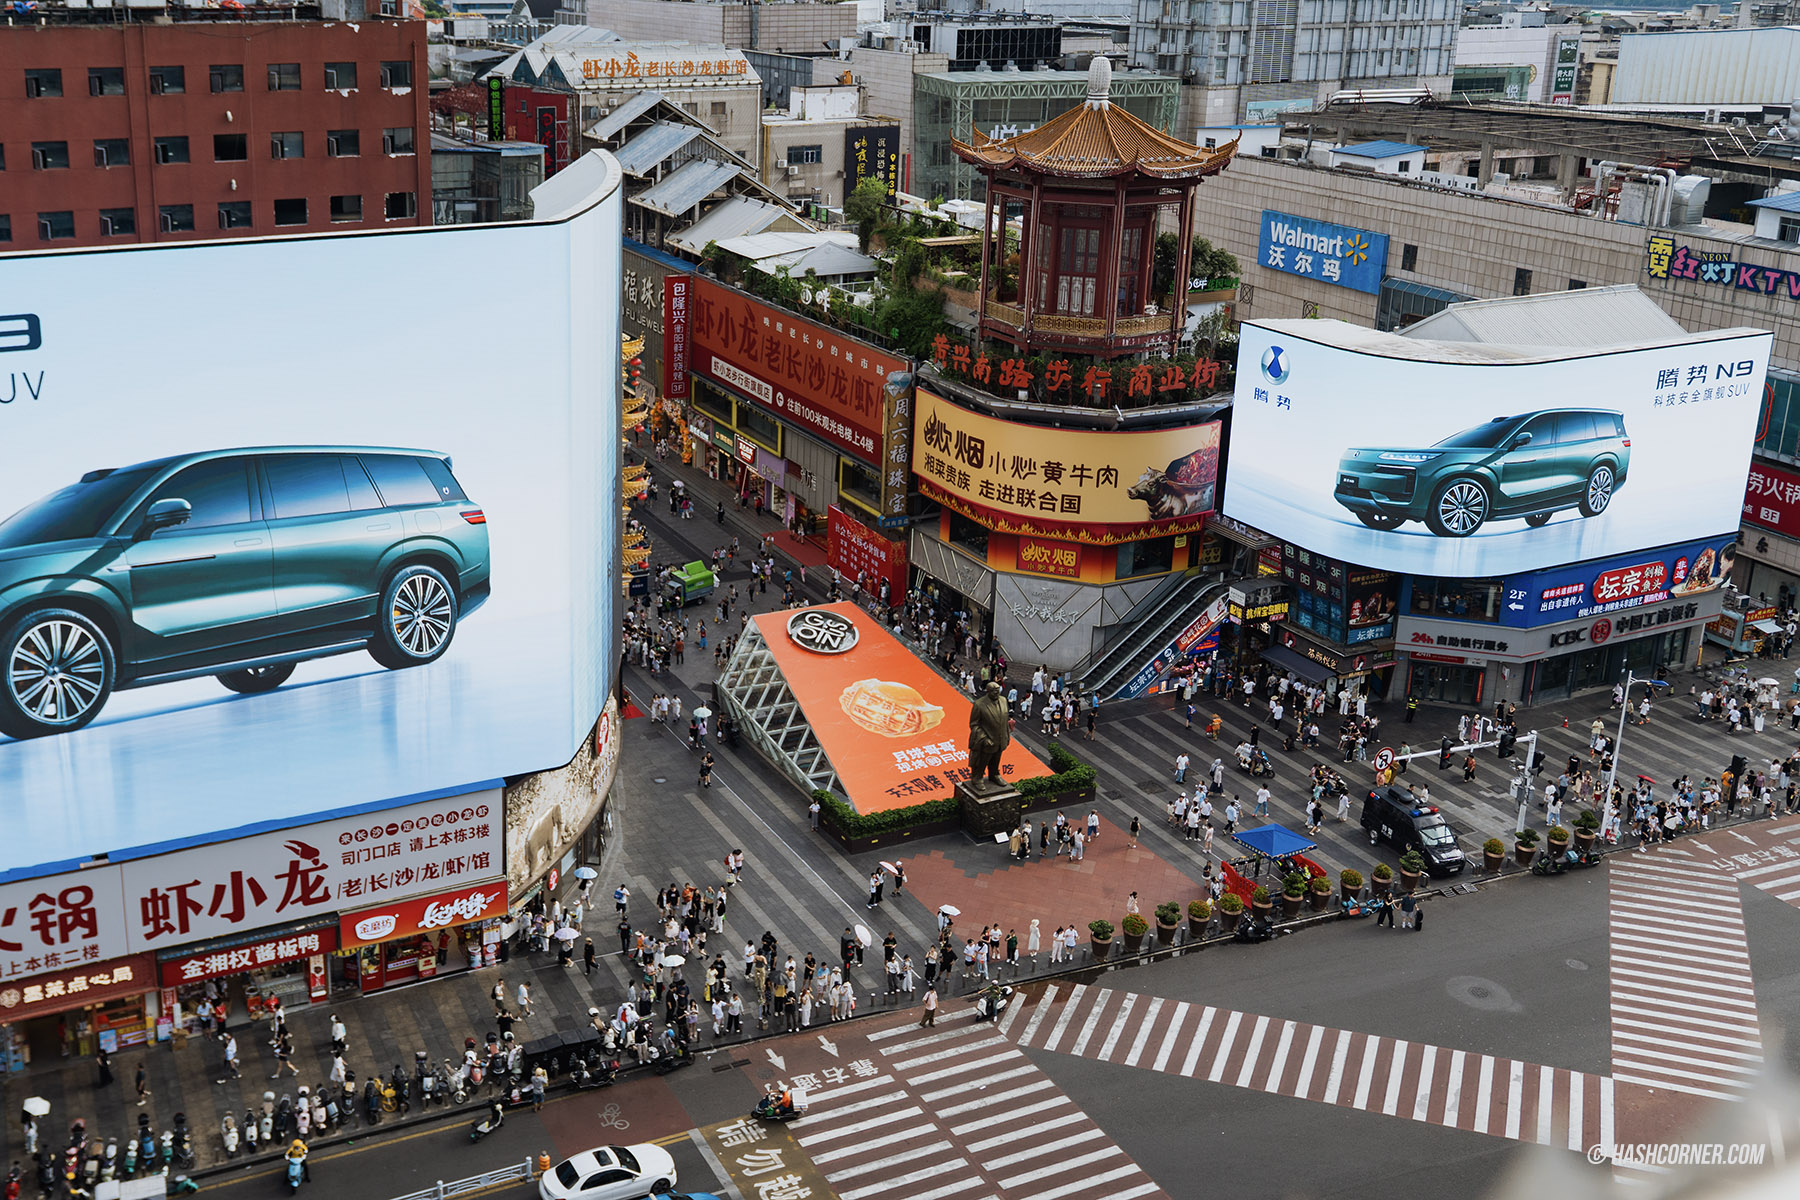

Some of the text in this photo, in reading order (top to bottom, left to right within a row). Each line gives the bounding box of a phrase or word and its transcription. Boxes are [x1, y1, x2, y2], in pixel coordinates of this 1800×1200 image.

[1270, 221, 1343, 258] Walmart
[1702, 253, 1728, 262] NEON
[1268, 244, 1341, 282] 沃尔玛
[673, 283, 686, 324] 包隆兴
[713, 360, 771, 400] 虾小龙步行街旗舰店
[931, 333, 1221, 398] 黄兴南路步行商业街
[1656, 359, 1754, 391] 腾势 N9
[673, 384, 683, 392] 3F
[1254, 387, 1291, 410] 腾势
[1653, 382, 1751, 409] 科技安全旗舰SUV
[787, 397, 874, 454] 往前100米观光电梯上4楼
[887, 398, 909, 513] 周六福珠宝
[988, 450, 1119, 489] 小炒黄牛肉
[923, 452, 1082, 514] 湘菜贵族 走进联合国
[1762, 508, 1778, 521] 3F
[1284, 543, 1327, 573] 包隆兴
[1330, 566, 1342, 578] 3F
[1509, 589, 1527, 600] 2F
[1597, 570, 1642, 599] 坛宗
[1011, 602, 1080, 625] 长沙我来了
[1550, 627, 1588, 648] ICBC
[1616, 602, 1698, 633] 中国工商银行
[1411, 632, 1509, 652] 24h 自助银行服务
[884, 774, 945, 798] 天天现烤
[338, 804, 490, 846] 来长沙一定要吃小龙虾
[341, 823, 491, 866] 司门口店 请上本栋3楼
[139, 840, 333, 942] 虾小龙
[0, 943, 100, 979] 上本栋二楼
